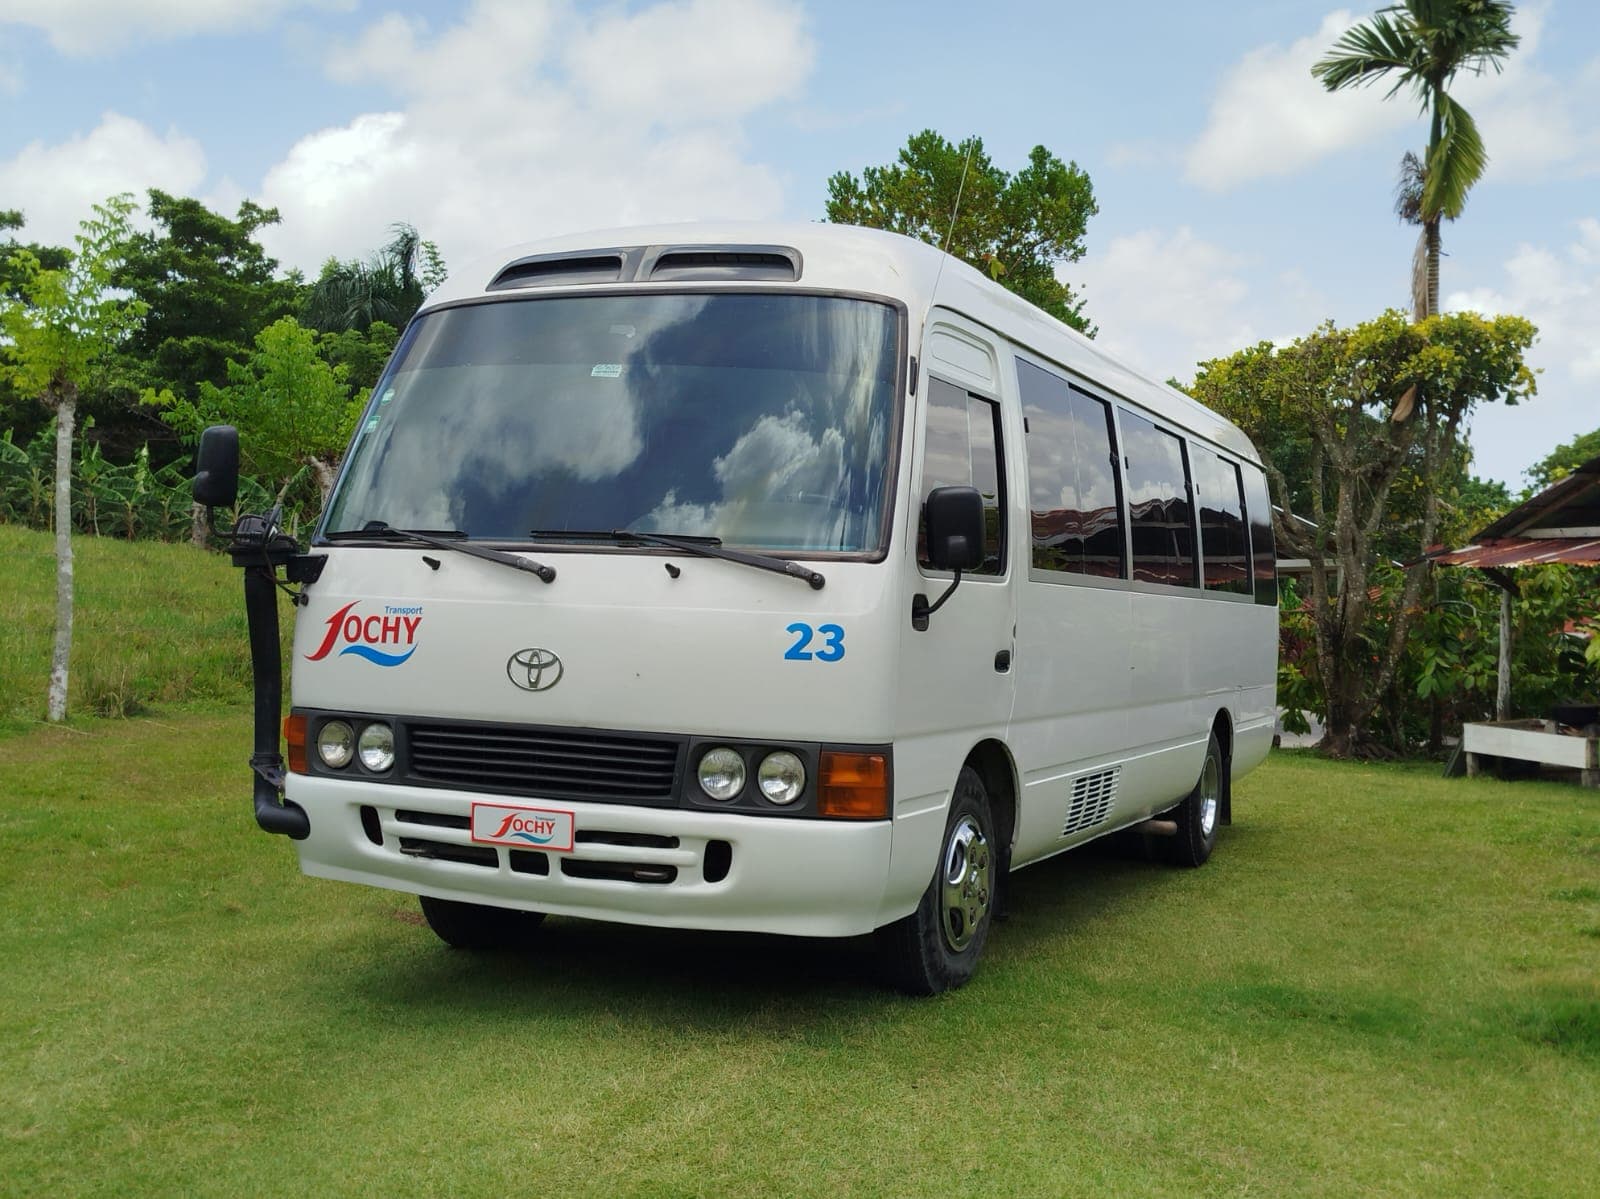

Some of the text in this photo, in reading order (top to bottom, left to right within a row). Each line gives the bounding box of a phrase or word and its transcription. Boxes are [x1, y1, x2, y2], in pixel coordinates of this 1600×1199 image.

[385, 605, 423, 615] Transport
[304, 600, 422, 661] JOCHY
[784, 622, 846, 662] 23
[488, 812, 556, 838] JOCHY
